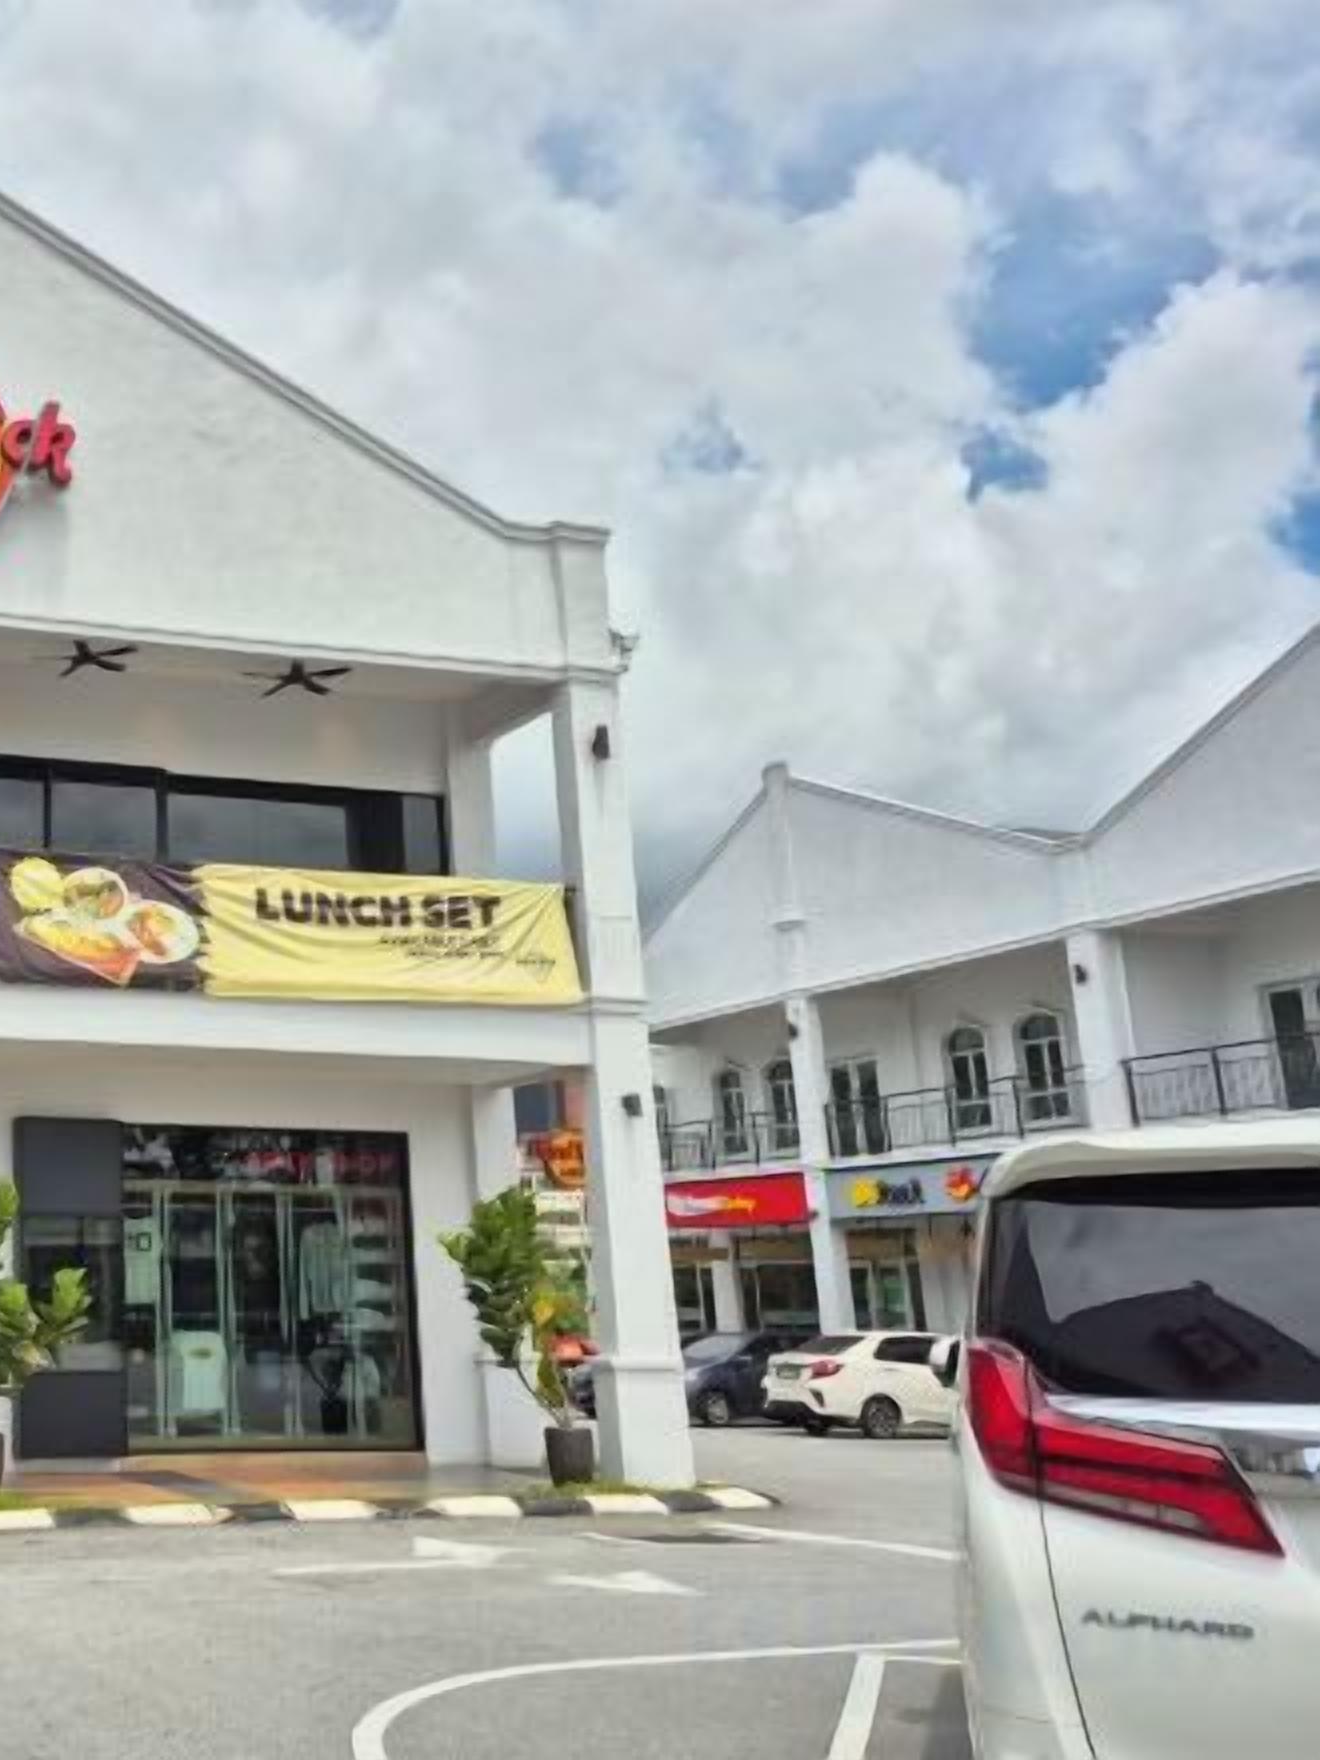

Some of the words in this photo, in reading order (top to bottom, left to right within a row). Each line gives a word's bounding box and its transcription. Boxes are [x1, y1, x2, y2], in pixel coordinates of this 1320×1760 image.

[256, 887, 412, 928] LUNCH
[421, 894, 501, 930] SET
[1081, 1608, 1256, 1640] ALPHARD
